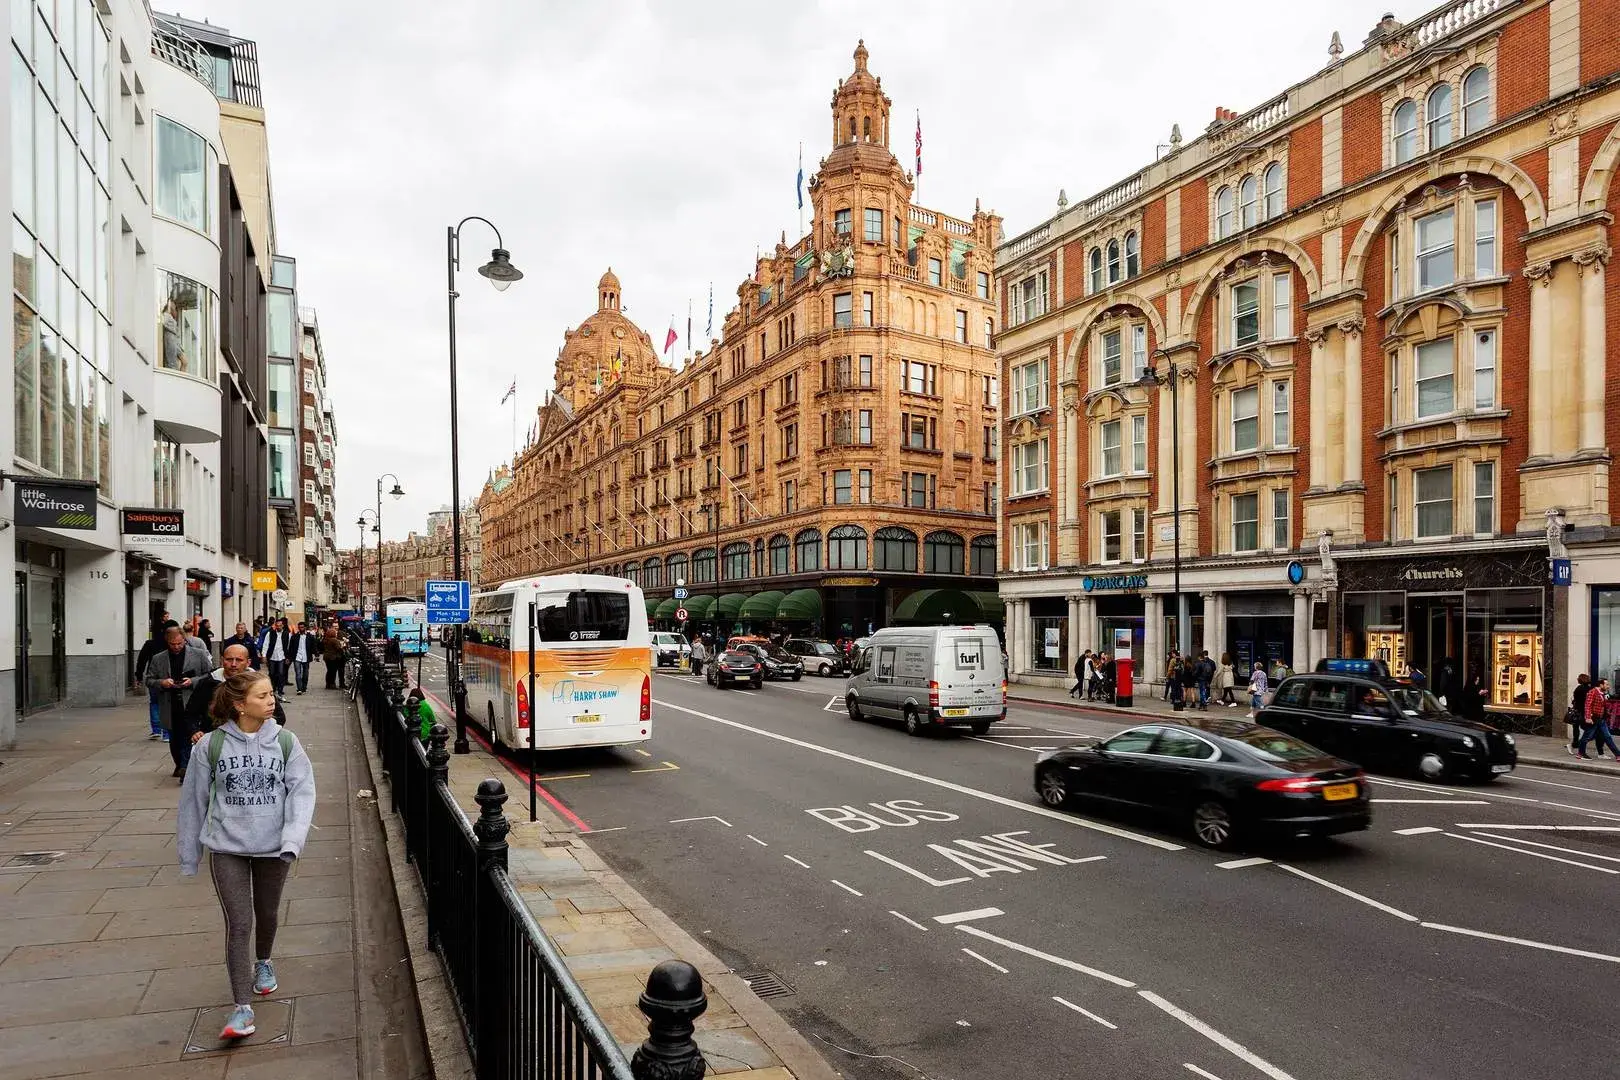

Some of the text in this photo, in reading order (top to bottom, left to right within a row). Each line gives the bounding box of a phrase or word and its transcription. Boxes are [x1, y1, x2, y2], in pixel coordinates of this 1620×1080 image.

[21, 489, 46, 499] little
[22, 498, 85, 511] Waitrose
[127, 514, 179, 523] Sainsbury's
[152, 523, 179, 532] Local
[90, 570, 109, 579] 116
[1405, 567, 1463, 580] Church's
[1559, 565, 1569, 579] GAP
[1093, 575, 1148, 589] BARCLAYS
[960, 652, 979, 663] furl
[574, 690, 618, 702] HARRY SHAW
[218, 754, 283, 774] BERLIN
[225, 795, 277, 806] GERMANY
[804, 799, 960, 833] BUS
[863, 830, 1108, 887] LANE
